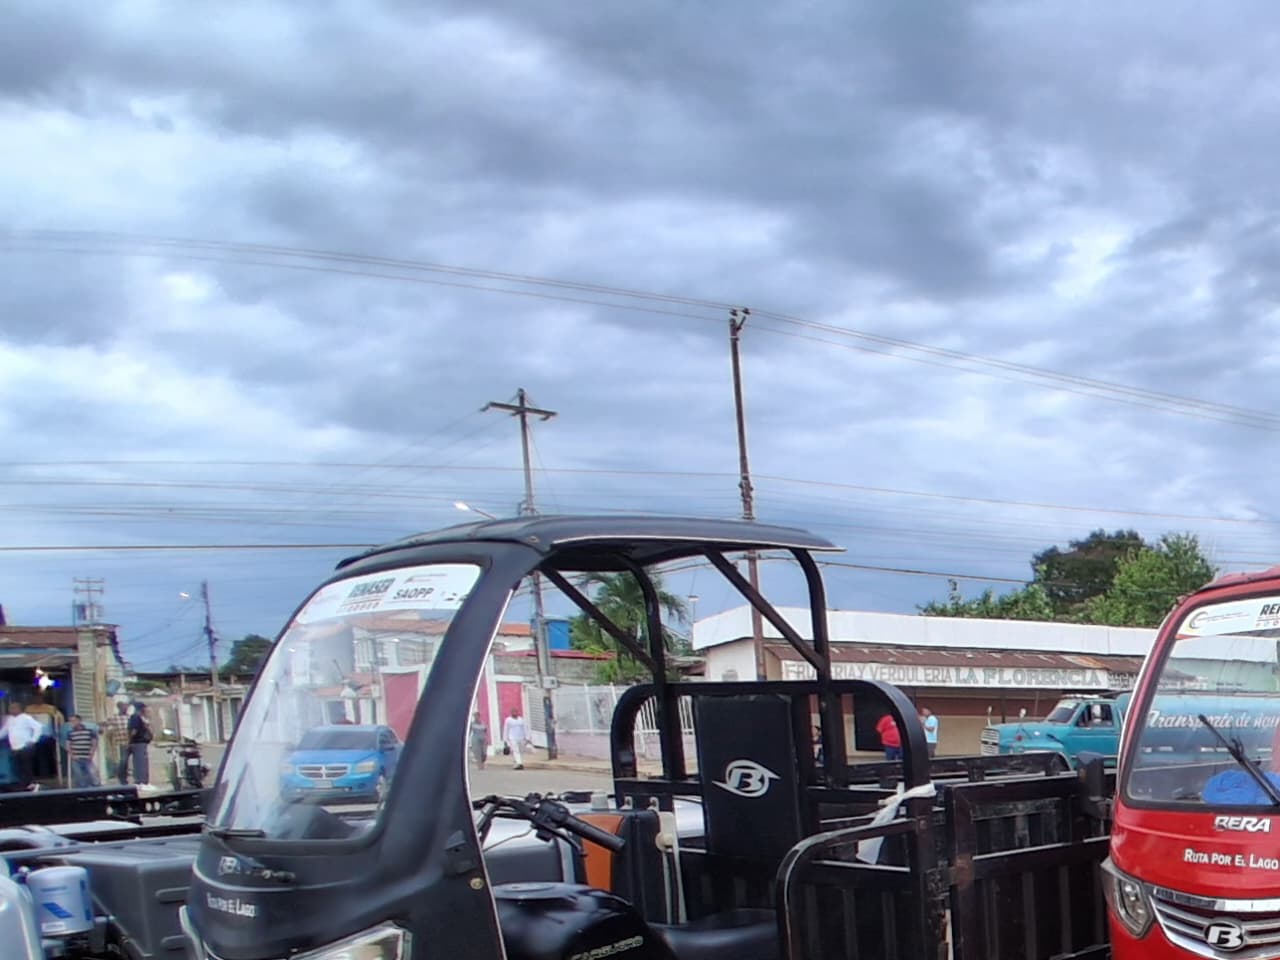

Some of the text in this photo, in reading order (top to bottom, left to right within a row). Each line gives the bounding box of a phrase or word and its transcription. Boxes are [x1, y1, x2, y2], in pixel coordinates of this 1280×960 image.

[954, 668, 976, 684] LA
[982, 668, 1101, 686] FLORENCIA
[1214, 816, 1271, 832] BERA
